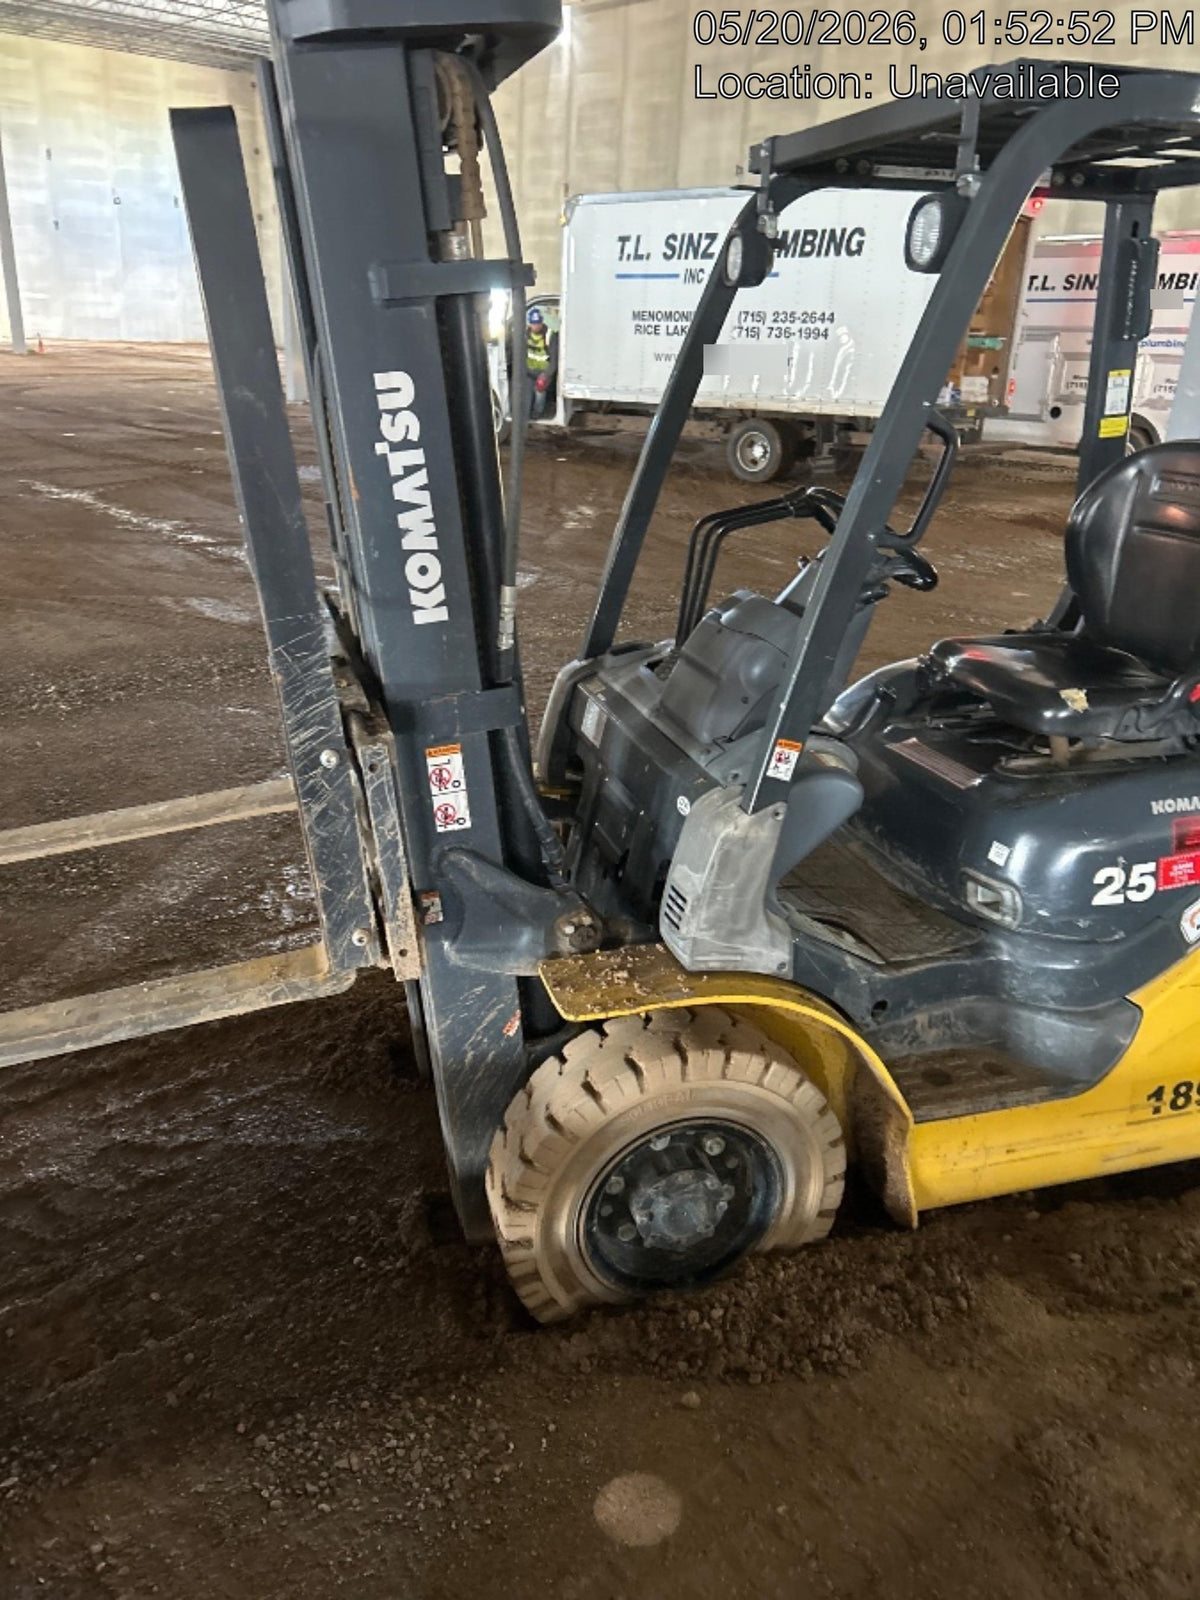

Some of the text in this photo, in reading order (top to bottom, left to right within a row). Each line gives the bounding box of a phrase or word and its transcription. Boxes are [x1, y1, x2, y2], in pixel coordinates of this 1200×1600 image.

[617, 227, 866, 261] T.L. SINZ MBING
[683, 267, 705, 284] INC
[1028, 275, 1055, 291] T.L.
[1063, 273, 1099, 290] SIN
[632, 310, 835, 325] MENOMONI (715) 235-2644
[634, 324, 661, 336] RICE
[666, 325, 688, 337] LAK
[767, 327, 829, 340] 736-1994
[373, 371, 449, 625] KOMATSU
[1151, 796, 1200, 815] KOMA
[1091, 862, 1156, 906] 25
[1146, 1080, 1200, 1116] 18
